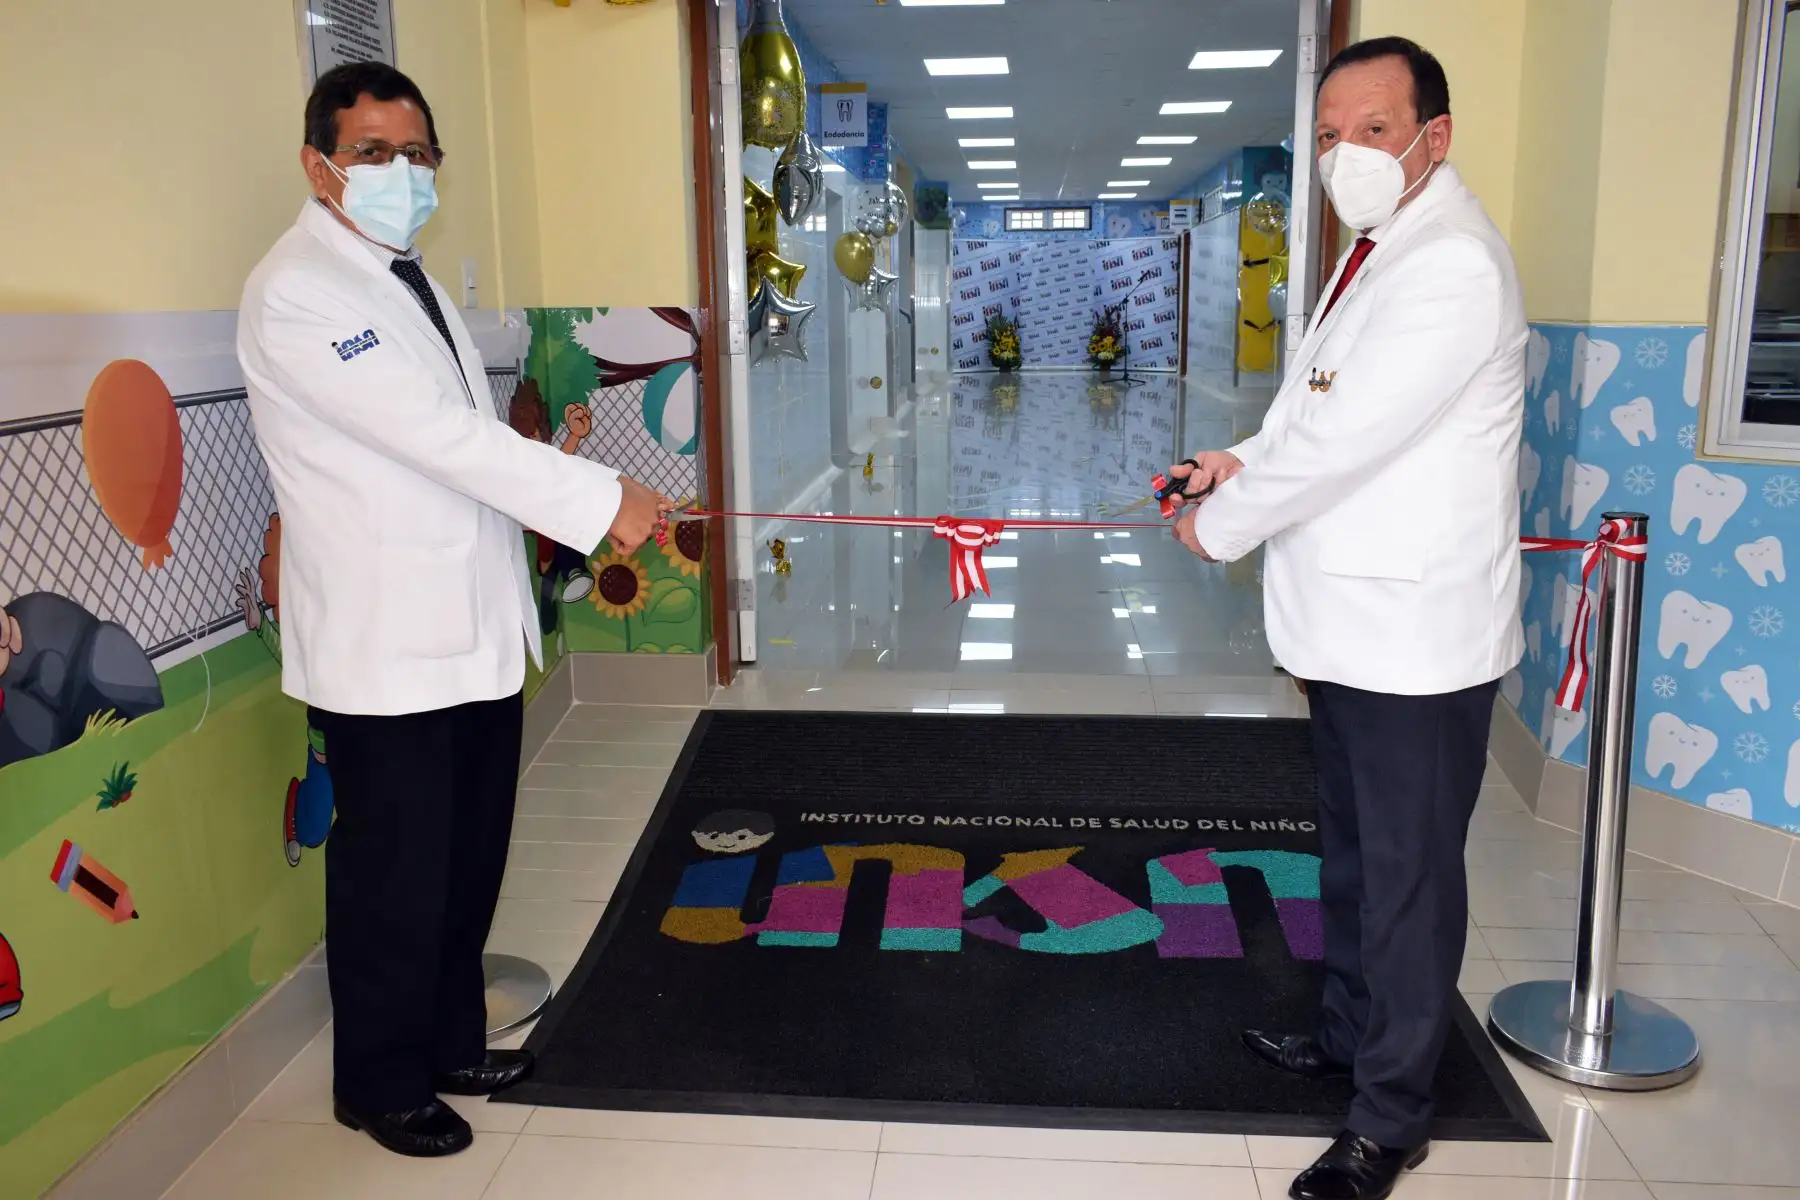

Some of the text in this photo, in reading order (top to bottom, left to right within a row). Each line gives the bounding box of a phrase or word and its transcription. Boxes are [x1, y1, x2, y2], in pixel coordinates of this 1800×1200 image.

[800, 812, 1317, 832] INSTITUTO NACIONAL DE SALUD DEL NIÑO
